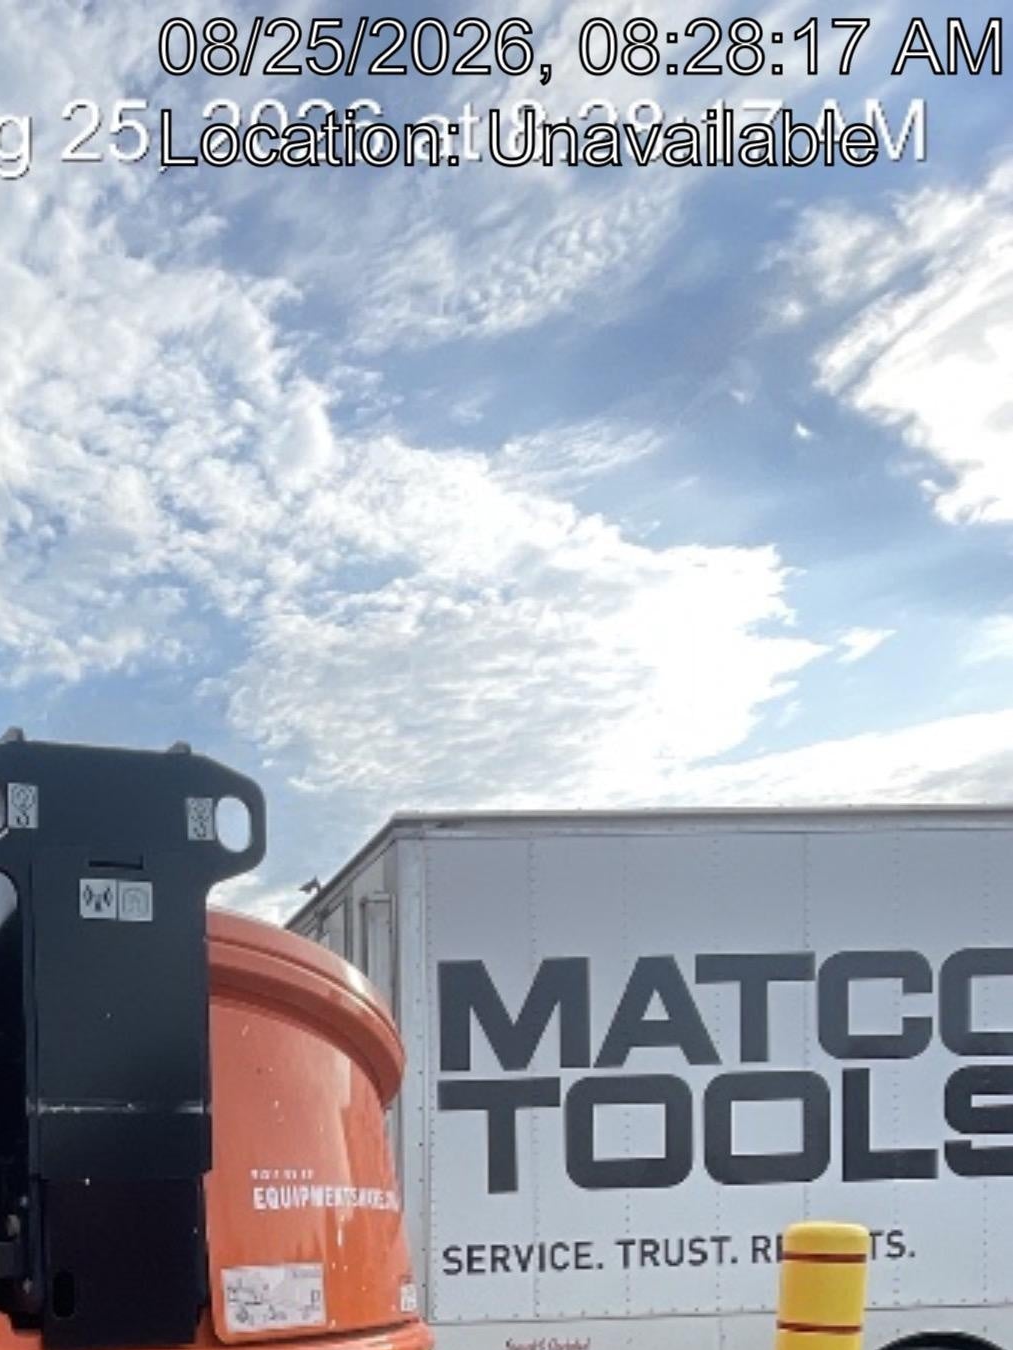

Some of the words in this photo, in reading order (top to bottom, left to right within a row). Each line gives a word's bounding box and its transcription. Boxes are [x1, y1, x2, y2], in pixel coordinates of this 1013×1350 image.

[437, 947, 1013, 1073] MATCO
[437, 1064, 1013, 1195] TOOLS
[441, 1240, 605, 1276] SERVICE.
[615, 1235, 739, 1269] TRUST.
[751, 1229, 916, 1264] RTS.
